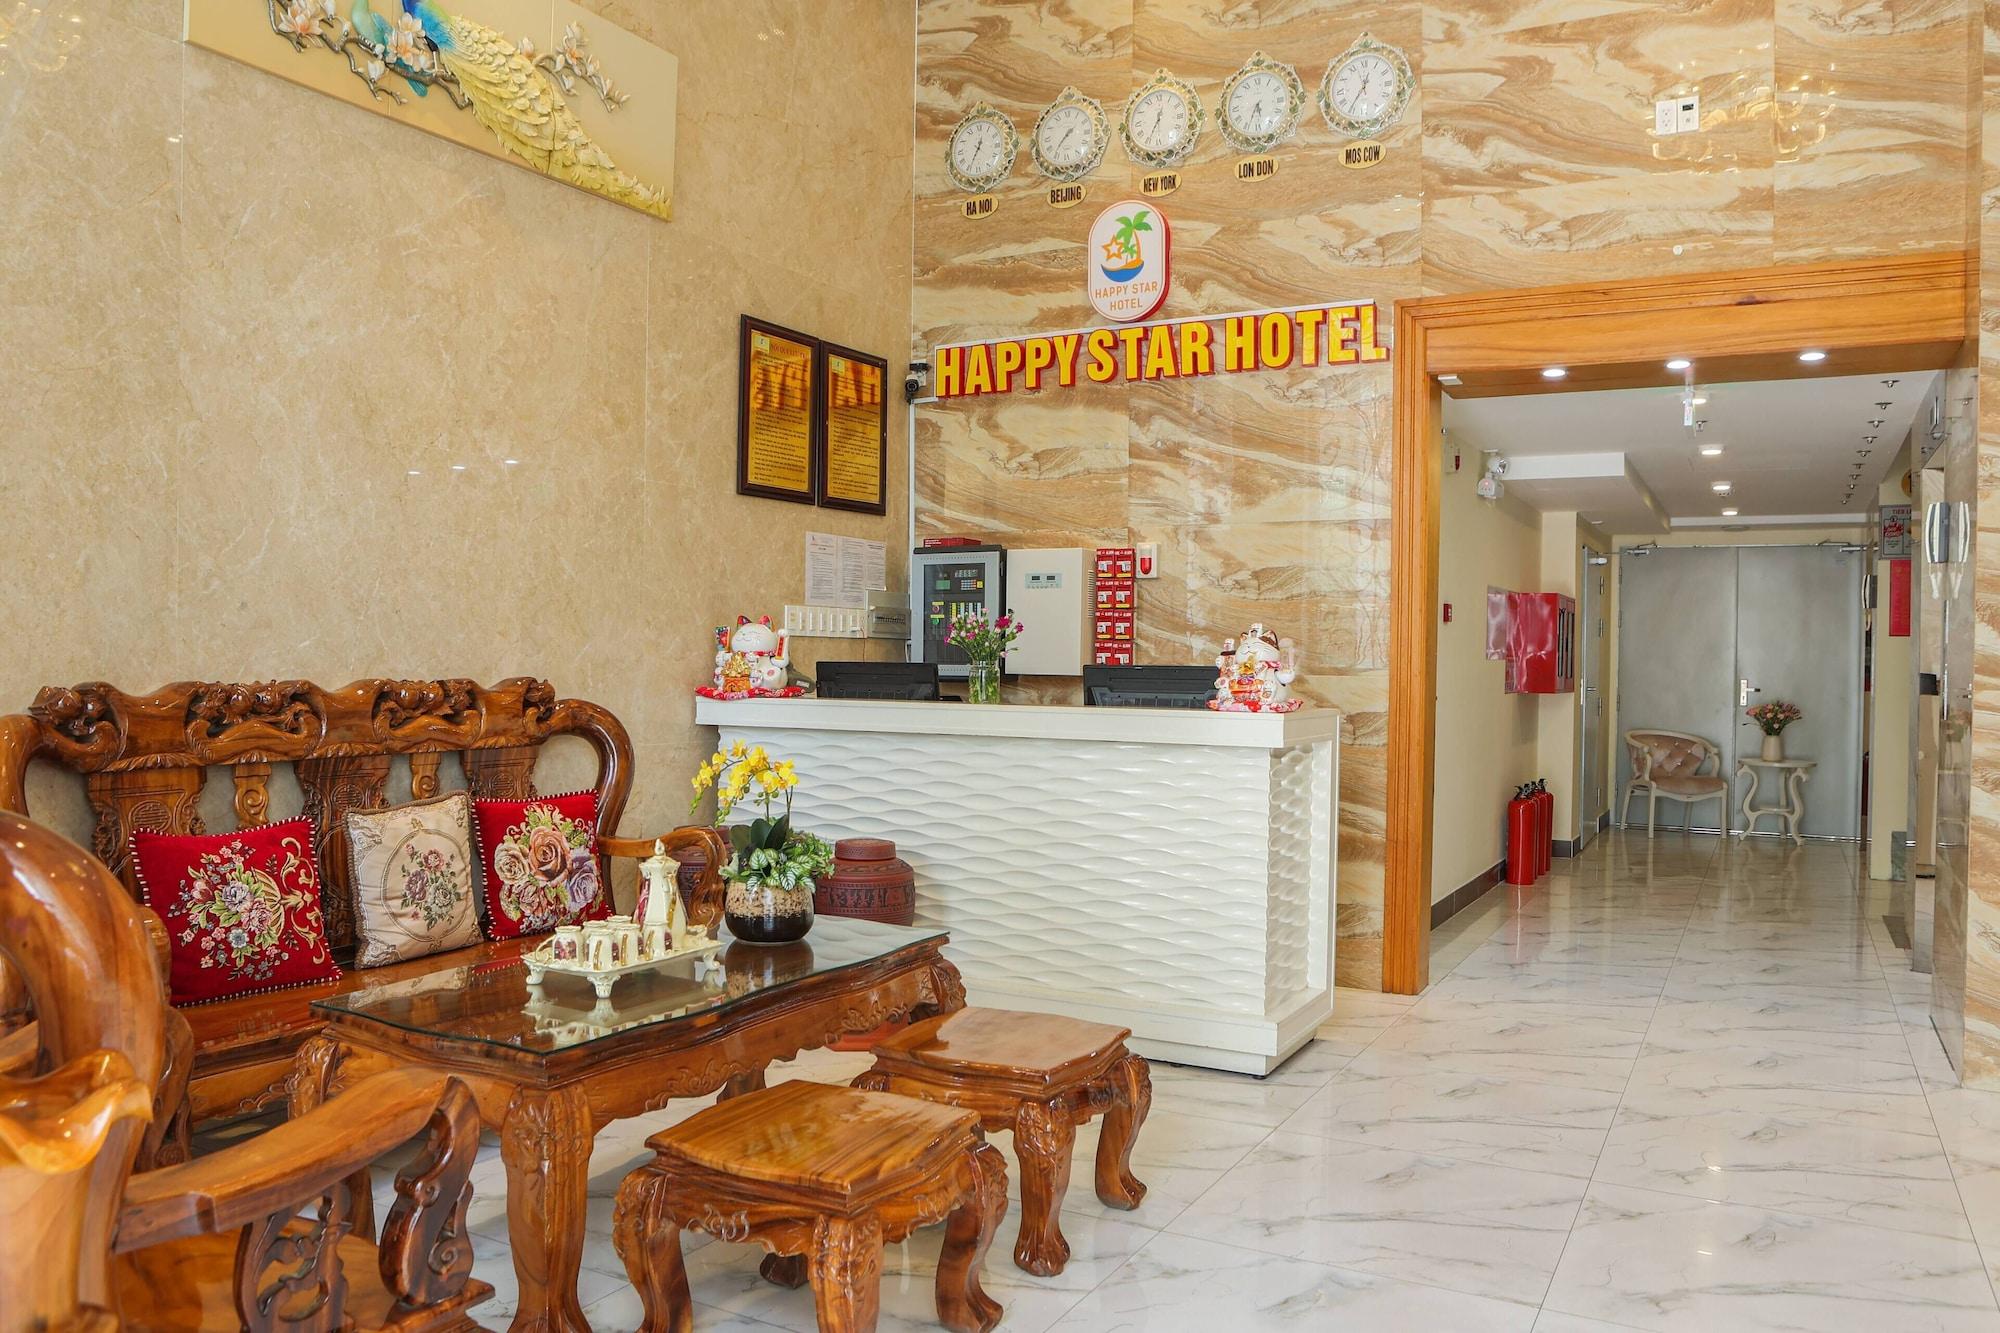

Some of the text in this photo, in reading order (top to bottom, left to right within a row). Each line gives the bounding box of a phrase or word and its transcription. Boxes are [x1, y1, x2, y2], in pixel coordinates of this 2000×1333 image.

[1345, 145, 1380, 165] MOS COW
[1238, 160, 1273, 178] LON DON
[1144, 175, 1177, 192] NEW YORK
[1050, 186, 1081, 204] BEIJING
[966, 198, 992, 216] HA NOI
[1096, 281, 1158, 298] HAPPY STAR
[1110, 298, 1143, 311] HOTEL
[936, 304, 1390, 398] HAPPY STAR HOTEL
